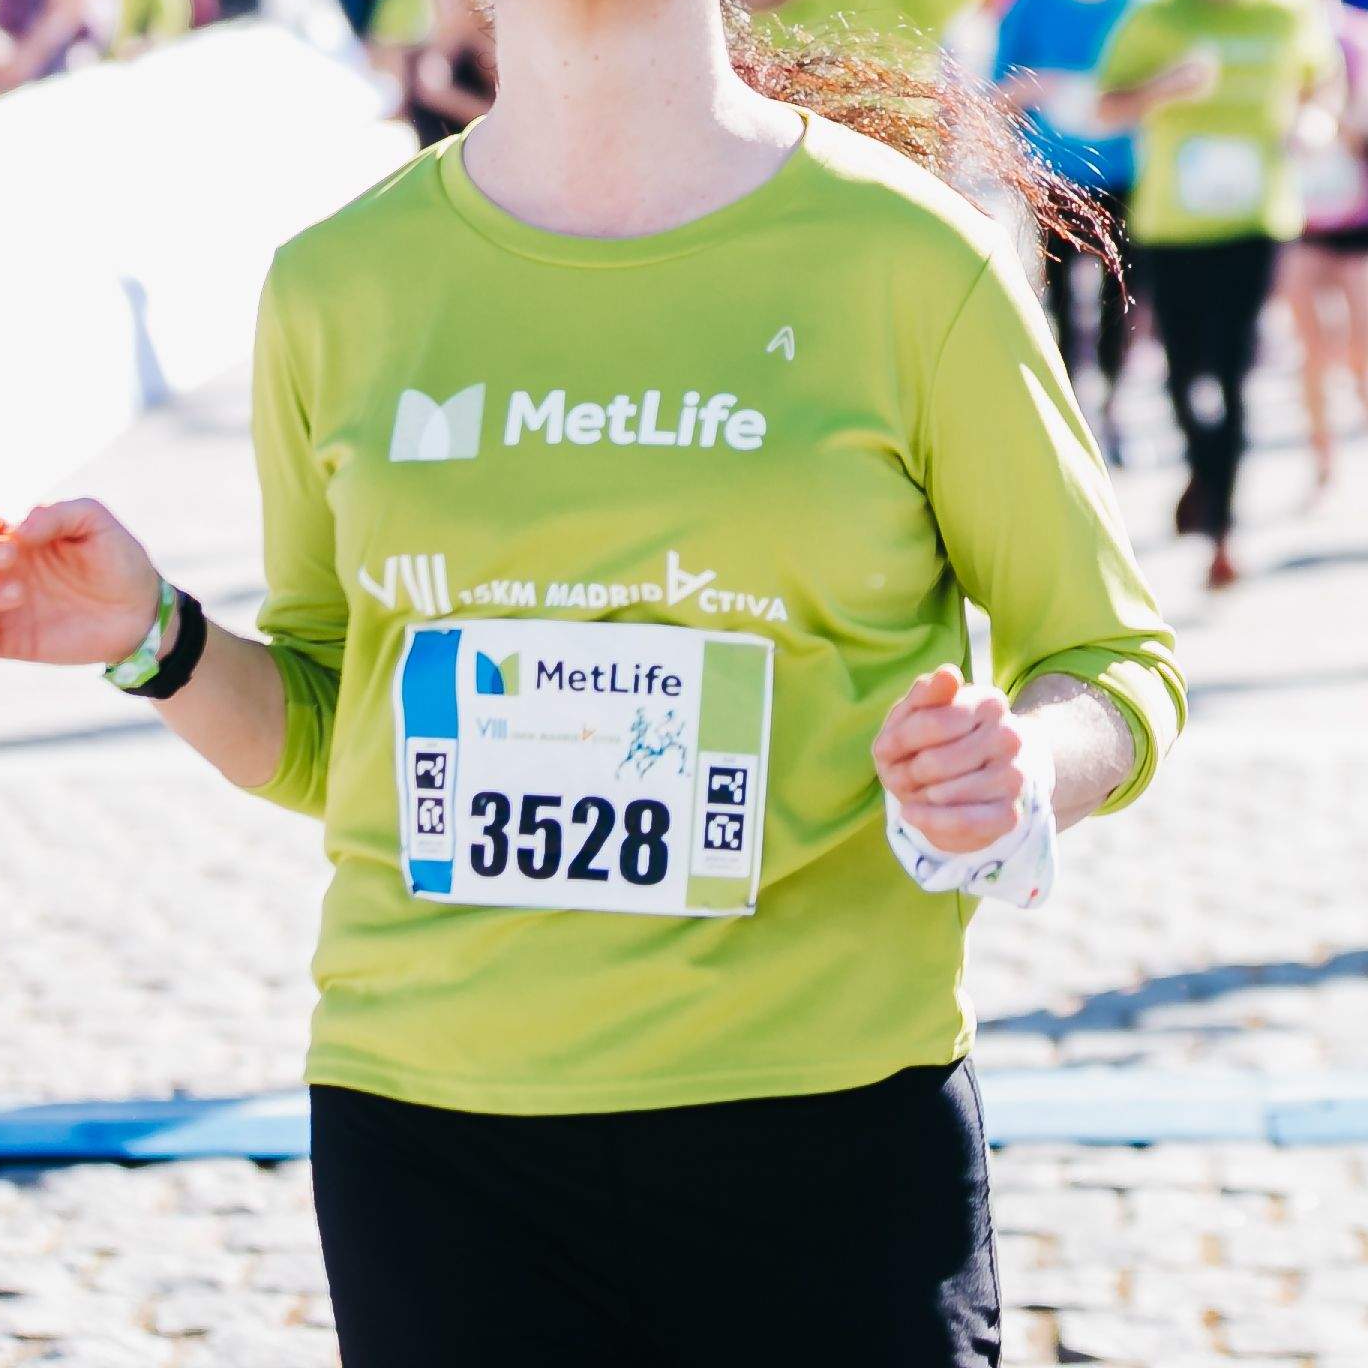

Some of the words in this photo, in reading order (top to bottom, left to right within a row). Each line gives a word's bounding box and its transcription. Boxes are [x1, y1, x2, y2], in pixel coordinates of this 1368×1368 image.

[504, 389, 767, 451] MetLife
[358, 552, 454, 615] VIII
[459, 579, 537, 607] 15KM
[544, 583, 663, 609] MADRID
[536, 659, 683, 697] MetLife
[469, 791, 671, 886] 3528
